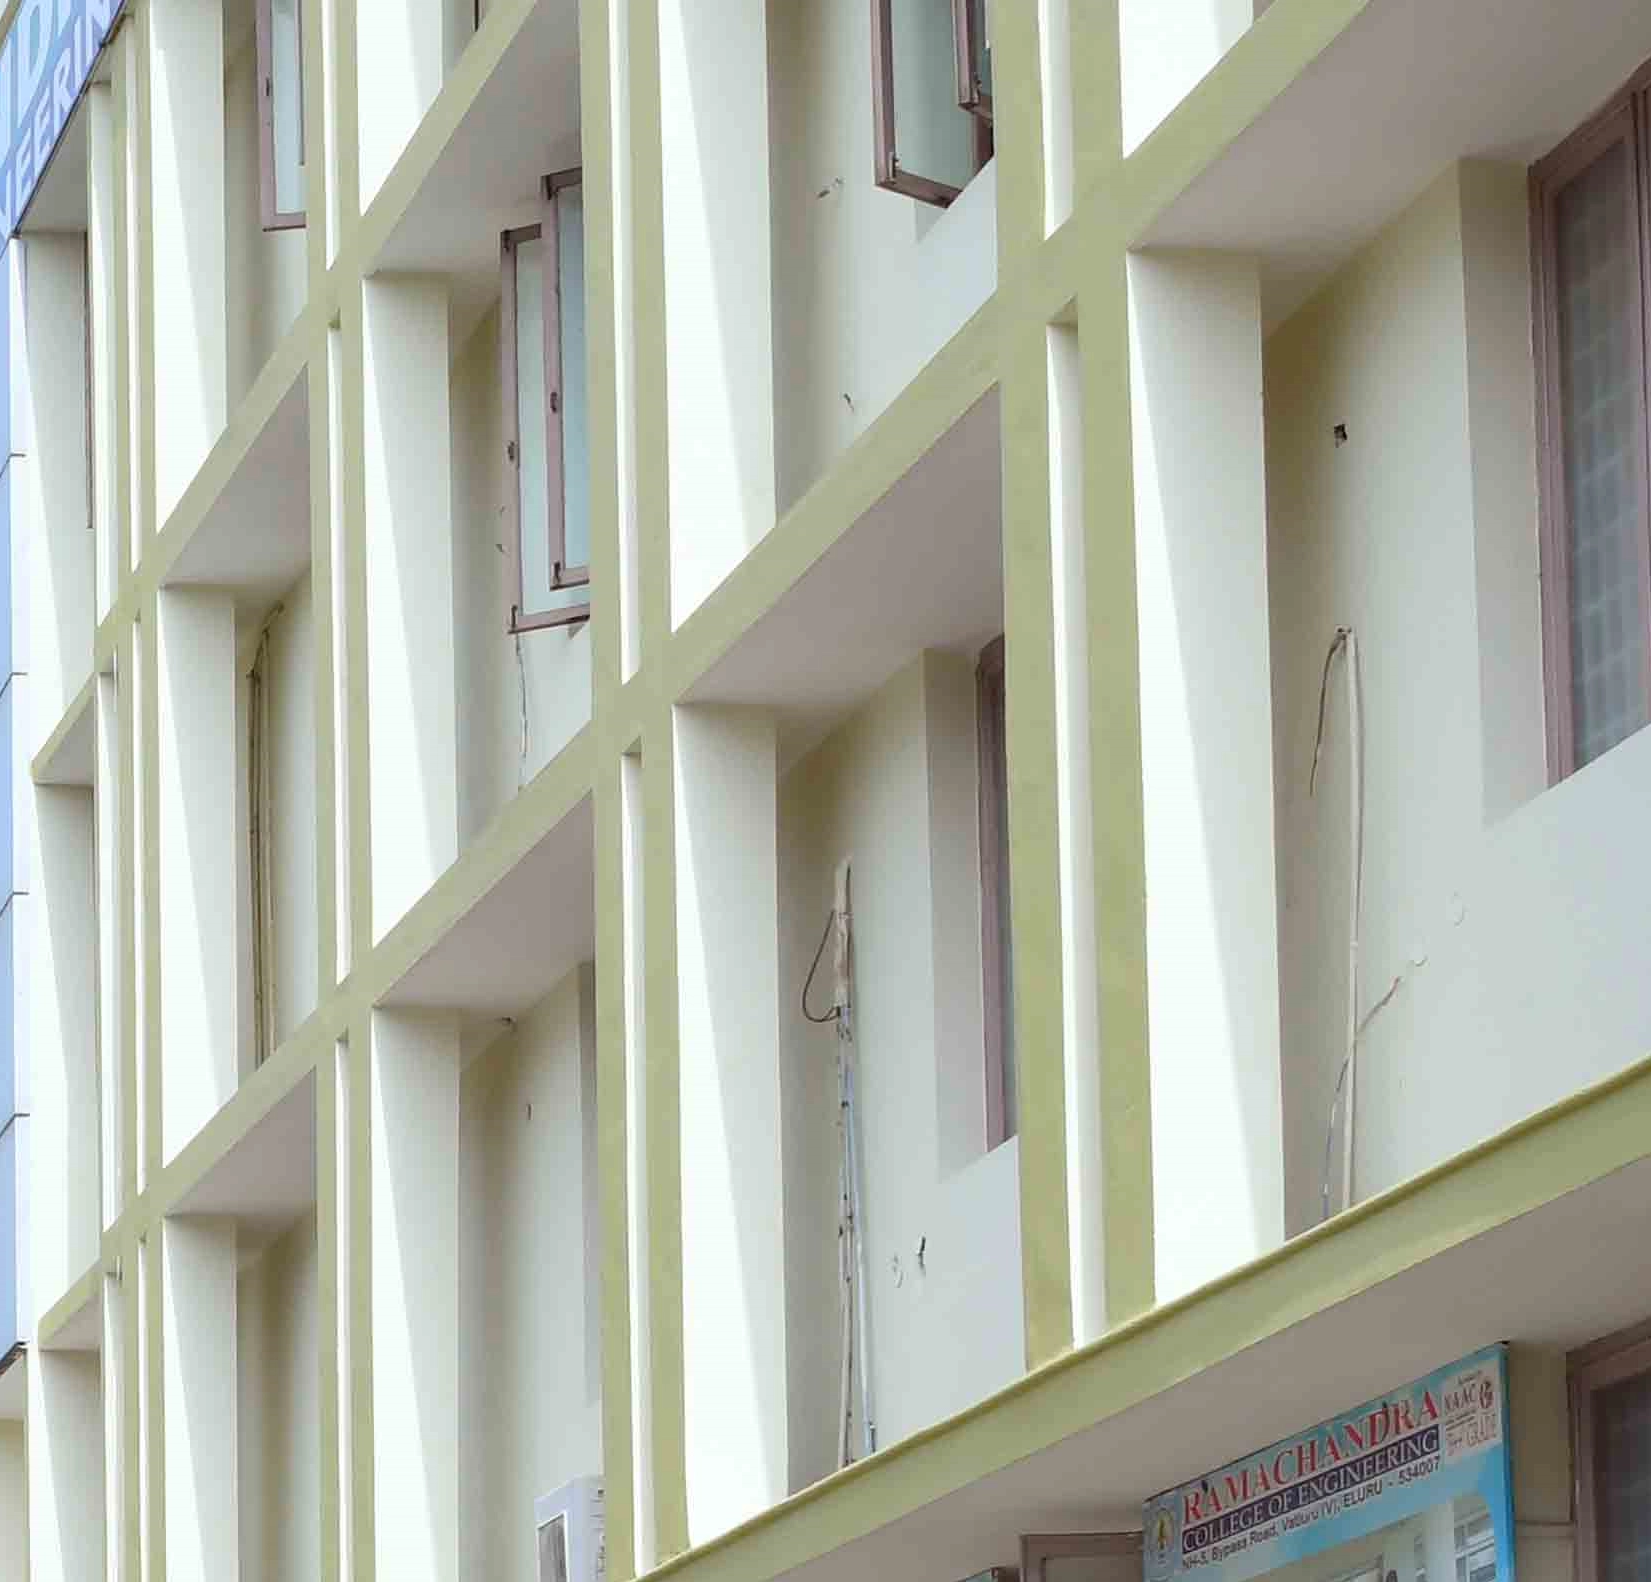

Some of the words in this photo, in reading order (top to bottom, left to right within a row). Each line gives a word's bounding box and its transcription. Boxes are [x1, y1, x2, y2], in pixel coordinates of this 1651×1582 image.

[1184, 1391, 1438, 1525] RAMACHANDRA
[1184, 1502, 1264, 1551] COLLEGE
[1268, 1491, 1292, 1516] OF
[1298, 1429, 1438, 1505] ENGINEERING
